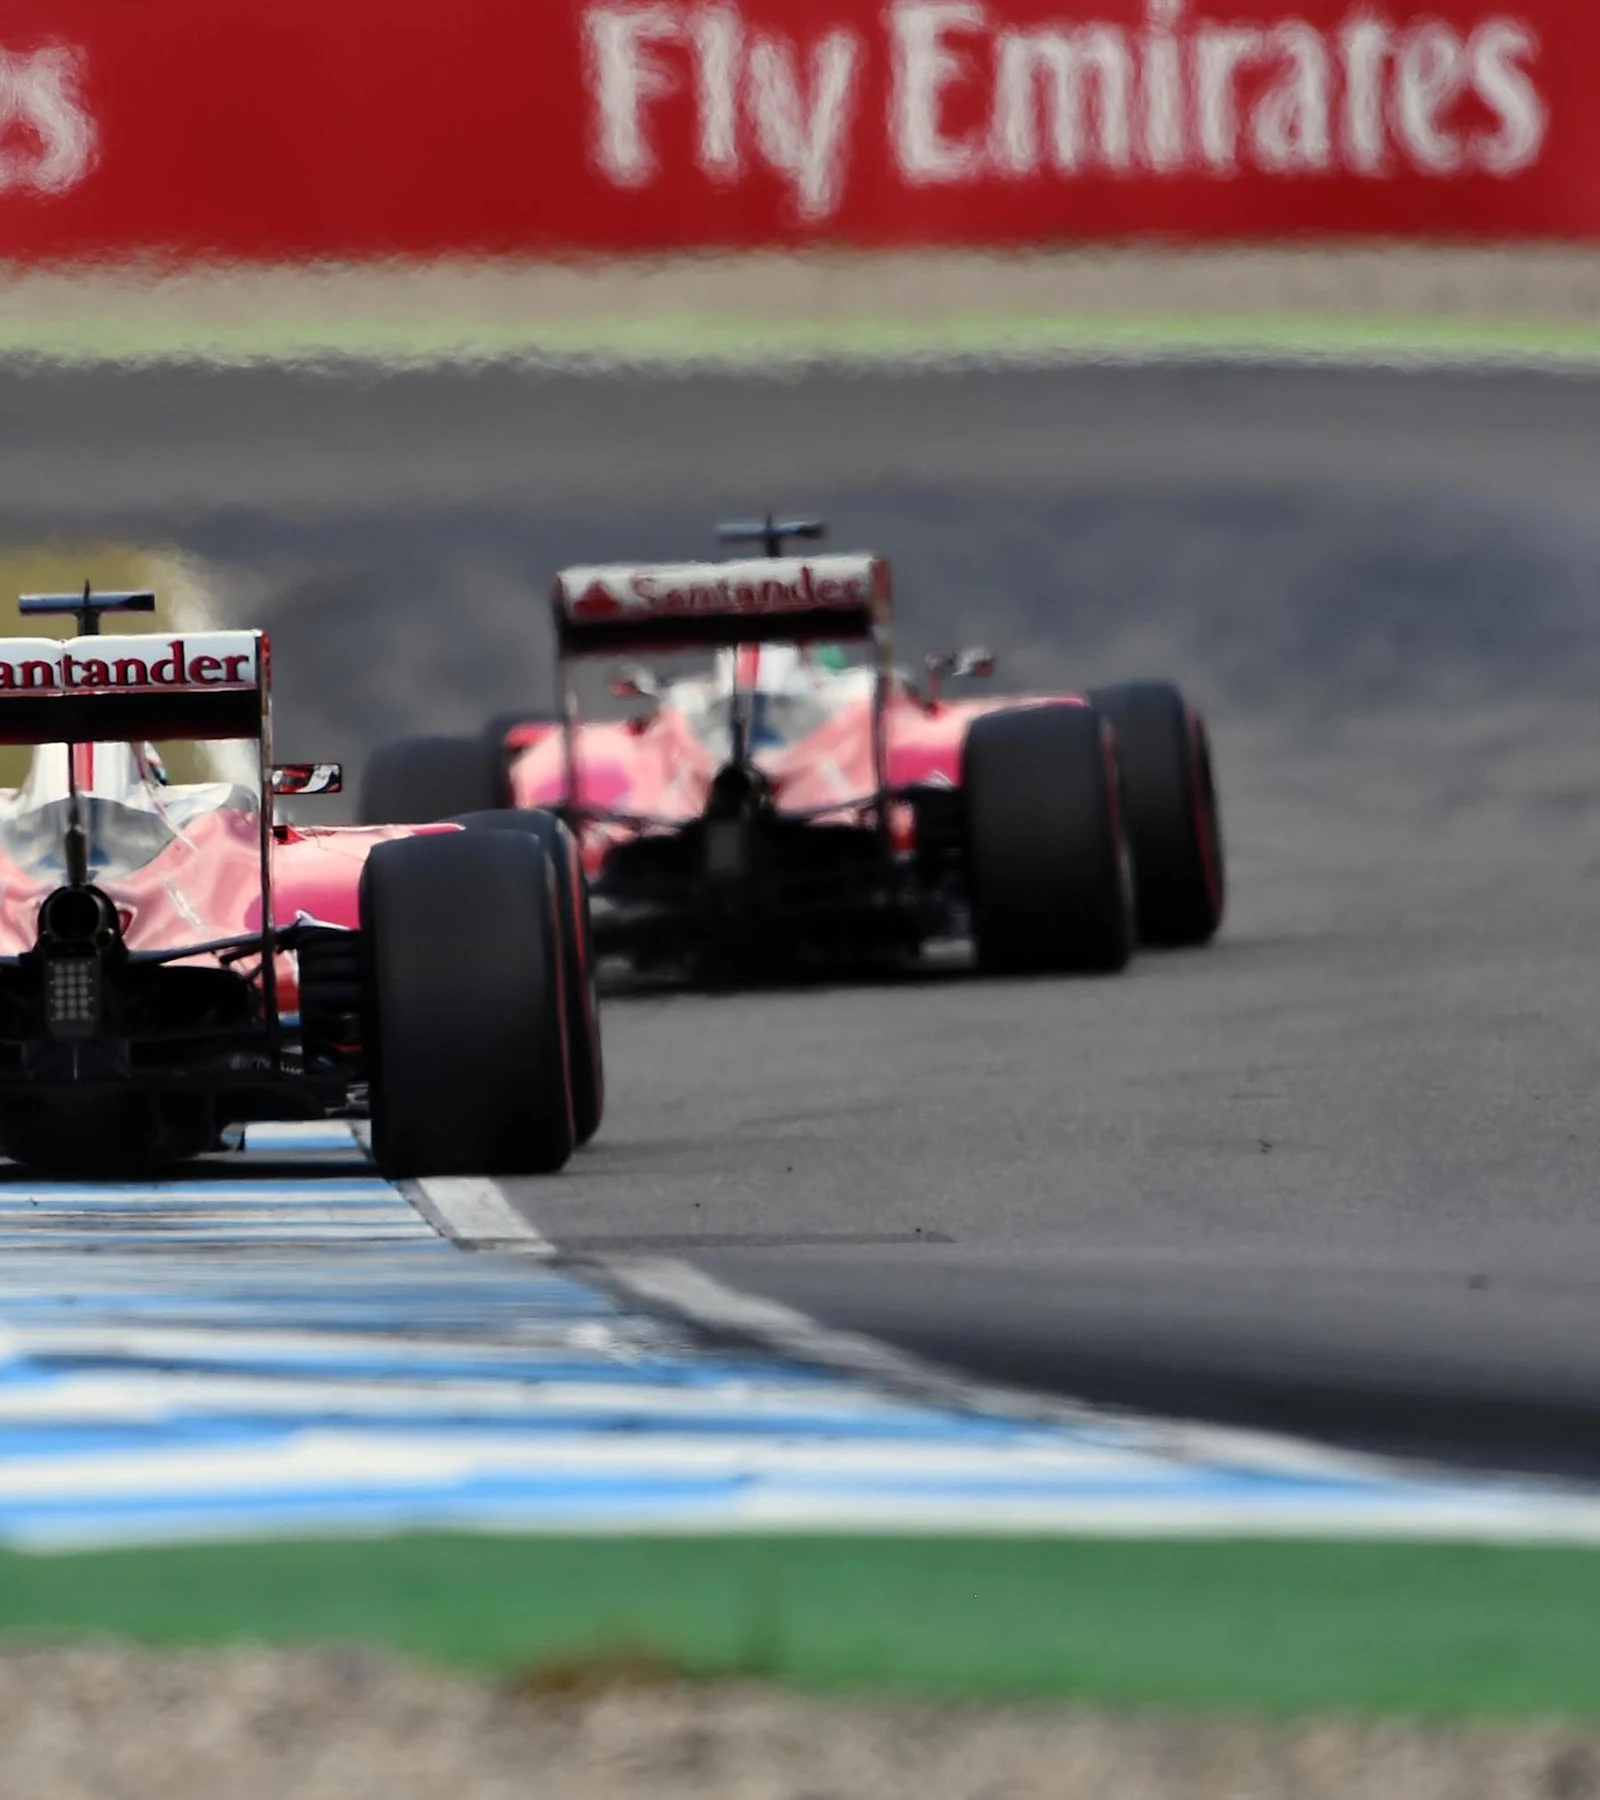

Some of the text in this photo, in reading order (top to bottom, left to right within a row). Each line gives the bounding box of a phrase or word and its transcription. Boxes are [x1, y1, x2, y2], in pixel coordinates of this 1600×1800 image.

[586, 0, 1546, 220] Fly Emirates
[629, 563, 863, 613] Santander
